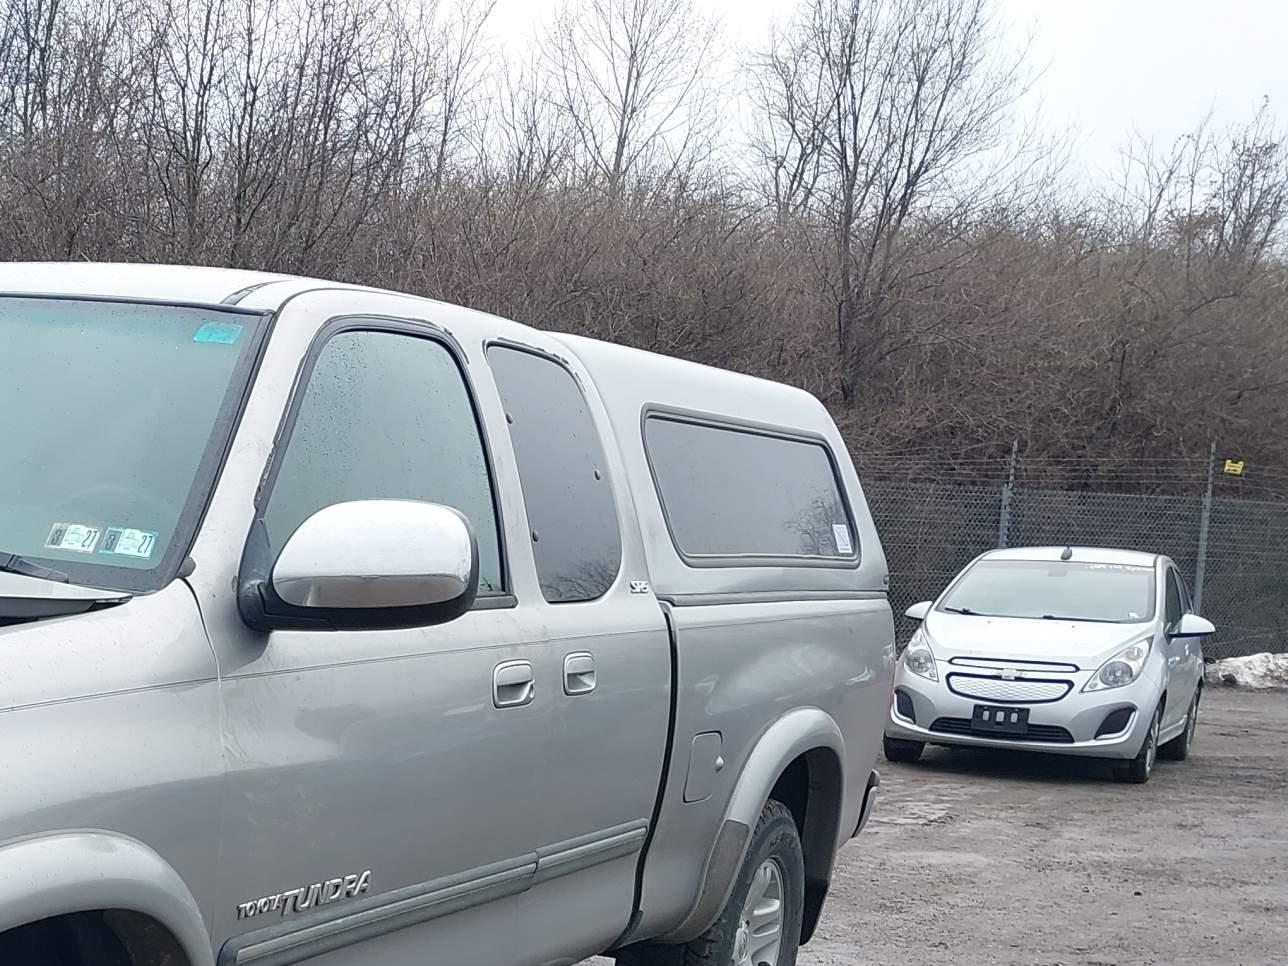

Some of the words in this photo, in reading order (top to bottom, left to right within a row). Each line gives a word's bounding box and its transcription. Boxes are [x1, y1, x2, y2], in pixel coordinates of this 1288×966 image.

[51, 529, 63, 546] 3
[81, 529, 98, 550] 27
[104, 534, 117, 551] 3
[137, 534, 154, 554] 27
[236, 894, 281, 920] TOYOTA
[280, 869, 372, 917] TUNDRA
